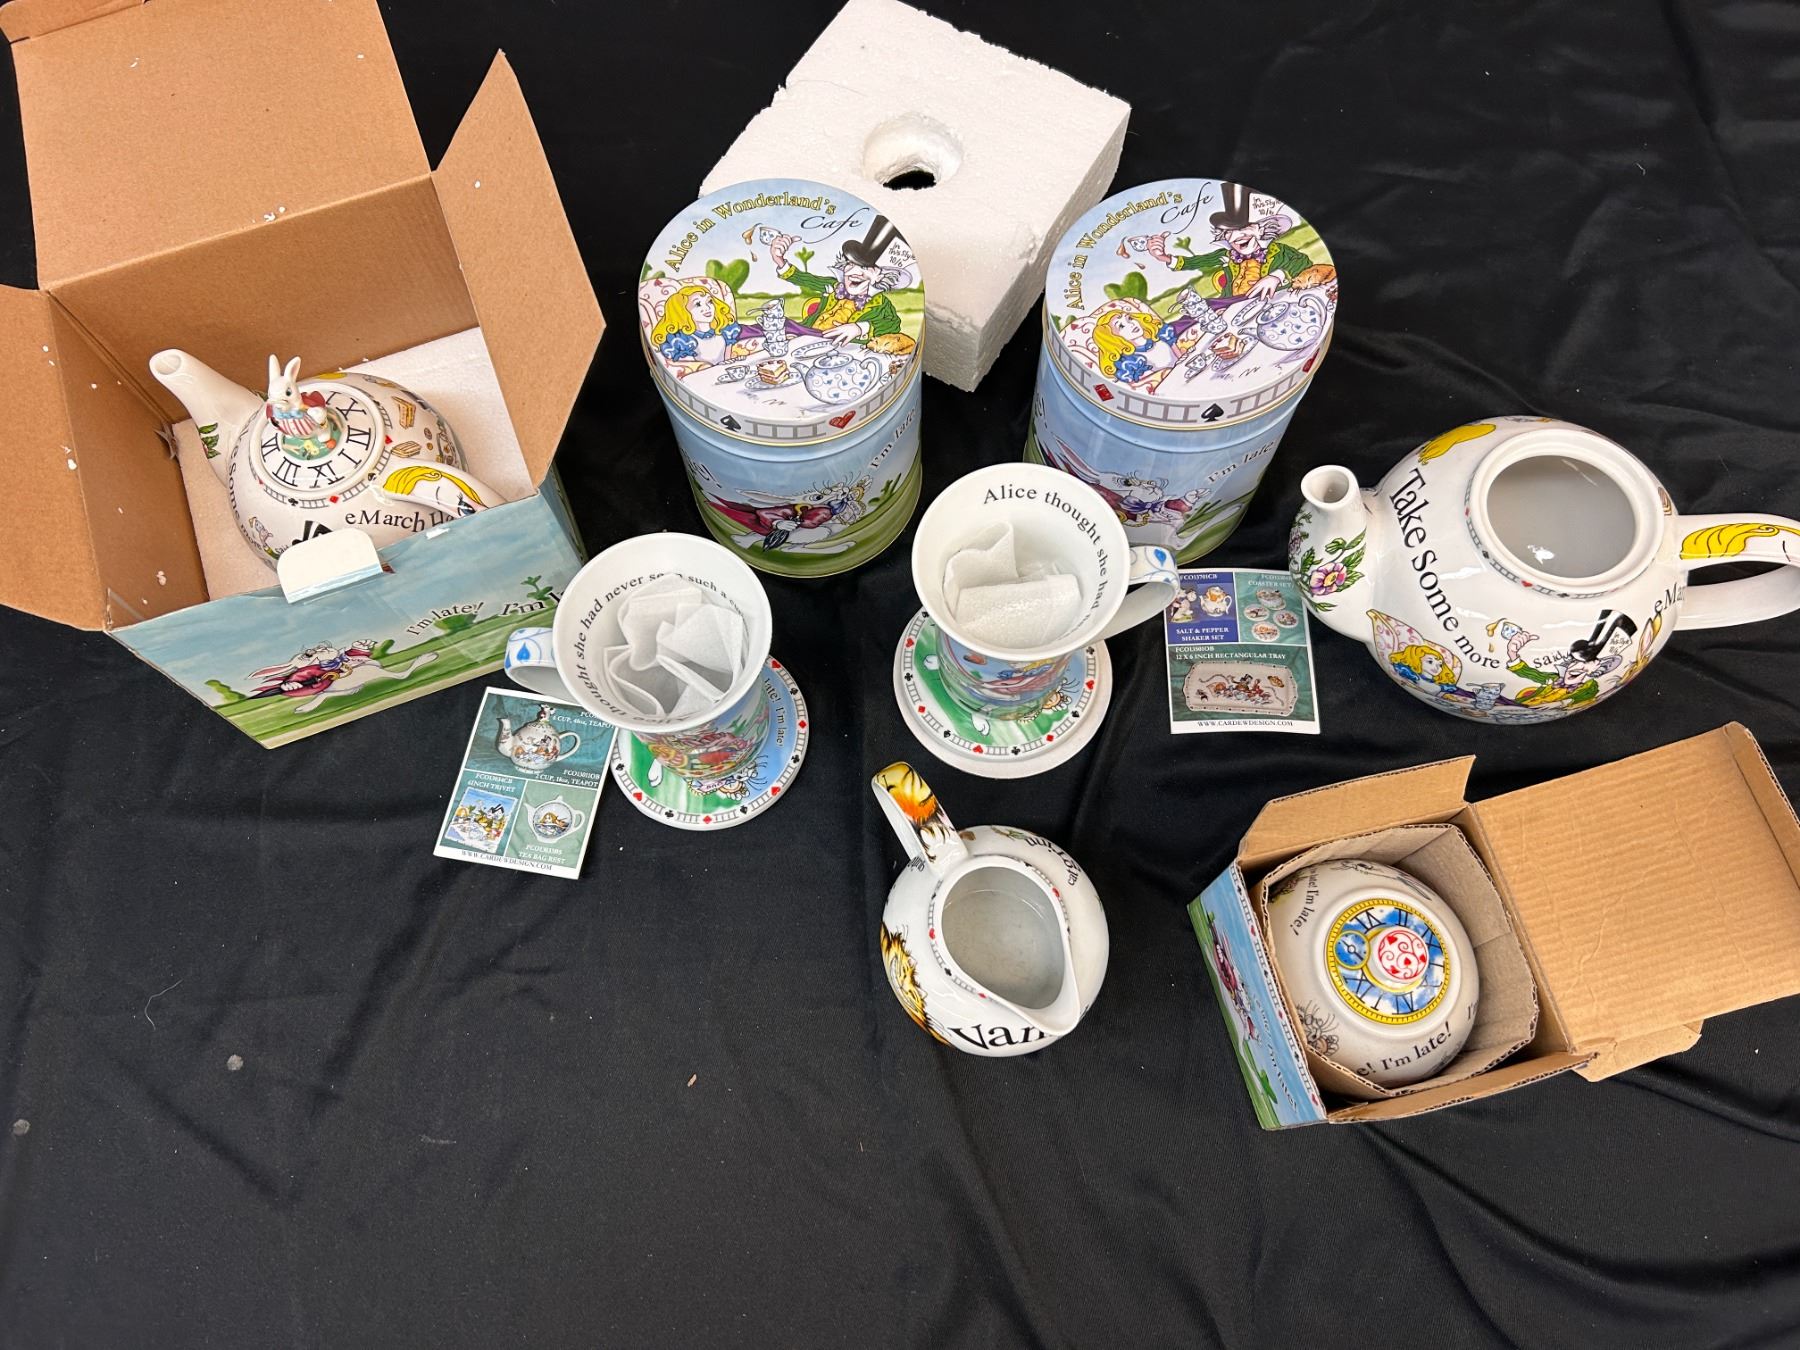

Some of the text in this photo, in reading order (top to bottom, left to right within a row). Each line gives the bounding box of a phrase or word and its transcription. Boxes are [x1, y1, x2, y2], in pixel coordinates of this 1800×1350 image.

[664, 191, 836, 272] Alice in Wonderland's
[1066, 191, 1183, 311] Alice in Wonderland's
[983, 483, 1108, 610] Alice thought she had
[1389, 467, 1500, 669] Take Some more
[605, 576, 644, 602] never
[688, 575, 718, 592] such
[406, 601, 546, 636] I'm late! I'm
[580, 598, 603, 629] had
[1176, 627, 1193, 635] SALT
[1202, 626, 1230, 634] PEPPER
[1181, 634, 1210, 642] SHAKER
[574, 632, 586, 660] she
[1195, 652, 1214, 660] INCH
[1215, 651, 1267, 660] RECTANGULAR
[1533, 651, 1563, 669] said
[576, 664, 627, 716] thought
[572, 778, 599, 788] TEAPOT
[518, 851, 567, 865] TEA BAG REST
[1306, 890, 1319, 905] I'm
[1290, 906, 1315, 936] late!
[1381, 1057, 1411, 1070] I'm
[1413, 1021, 1452, 1059] late!
